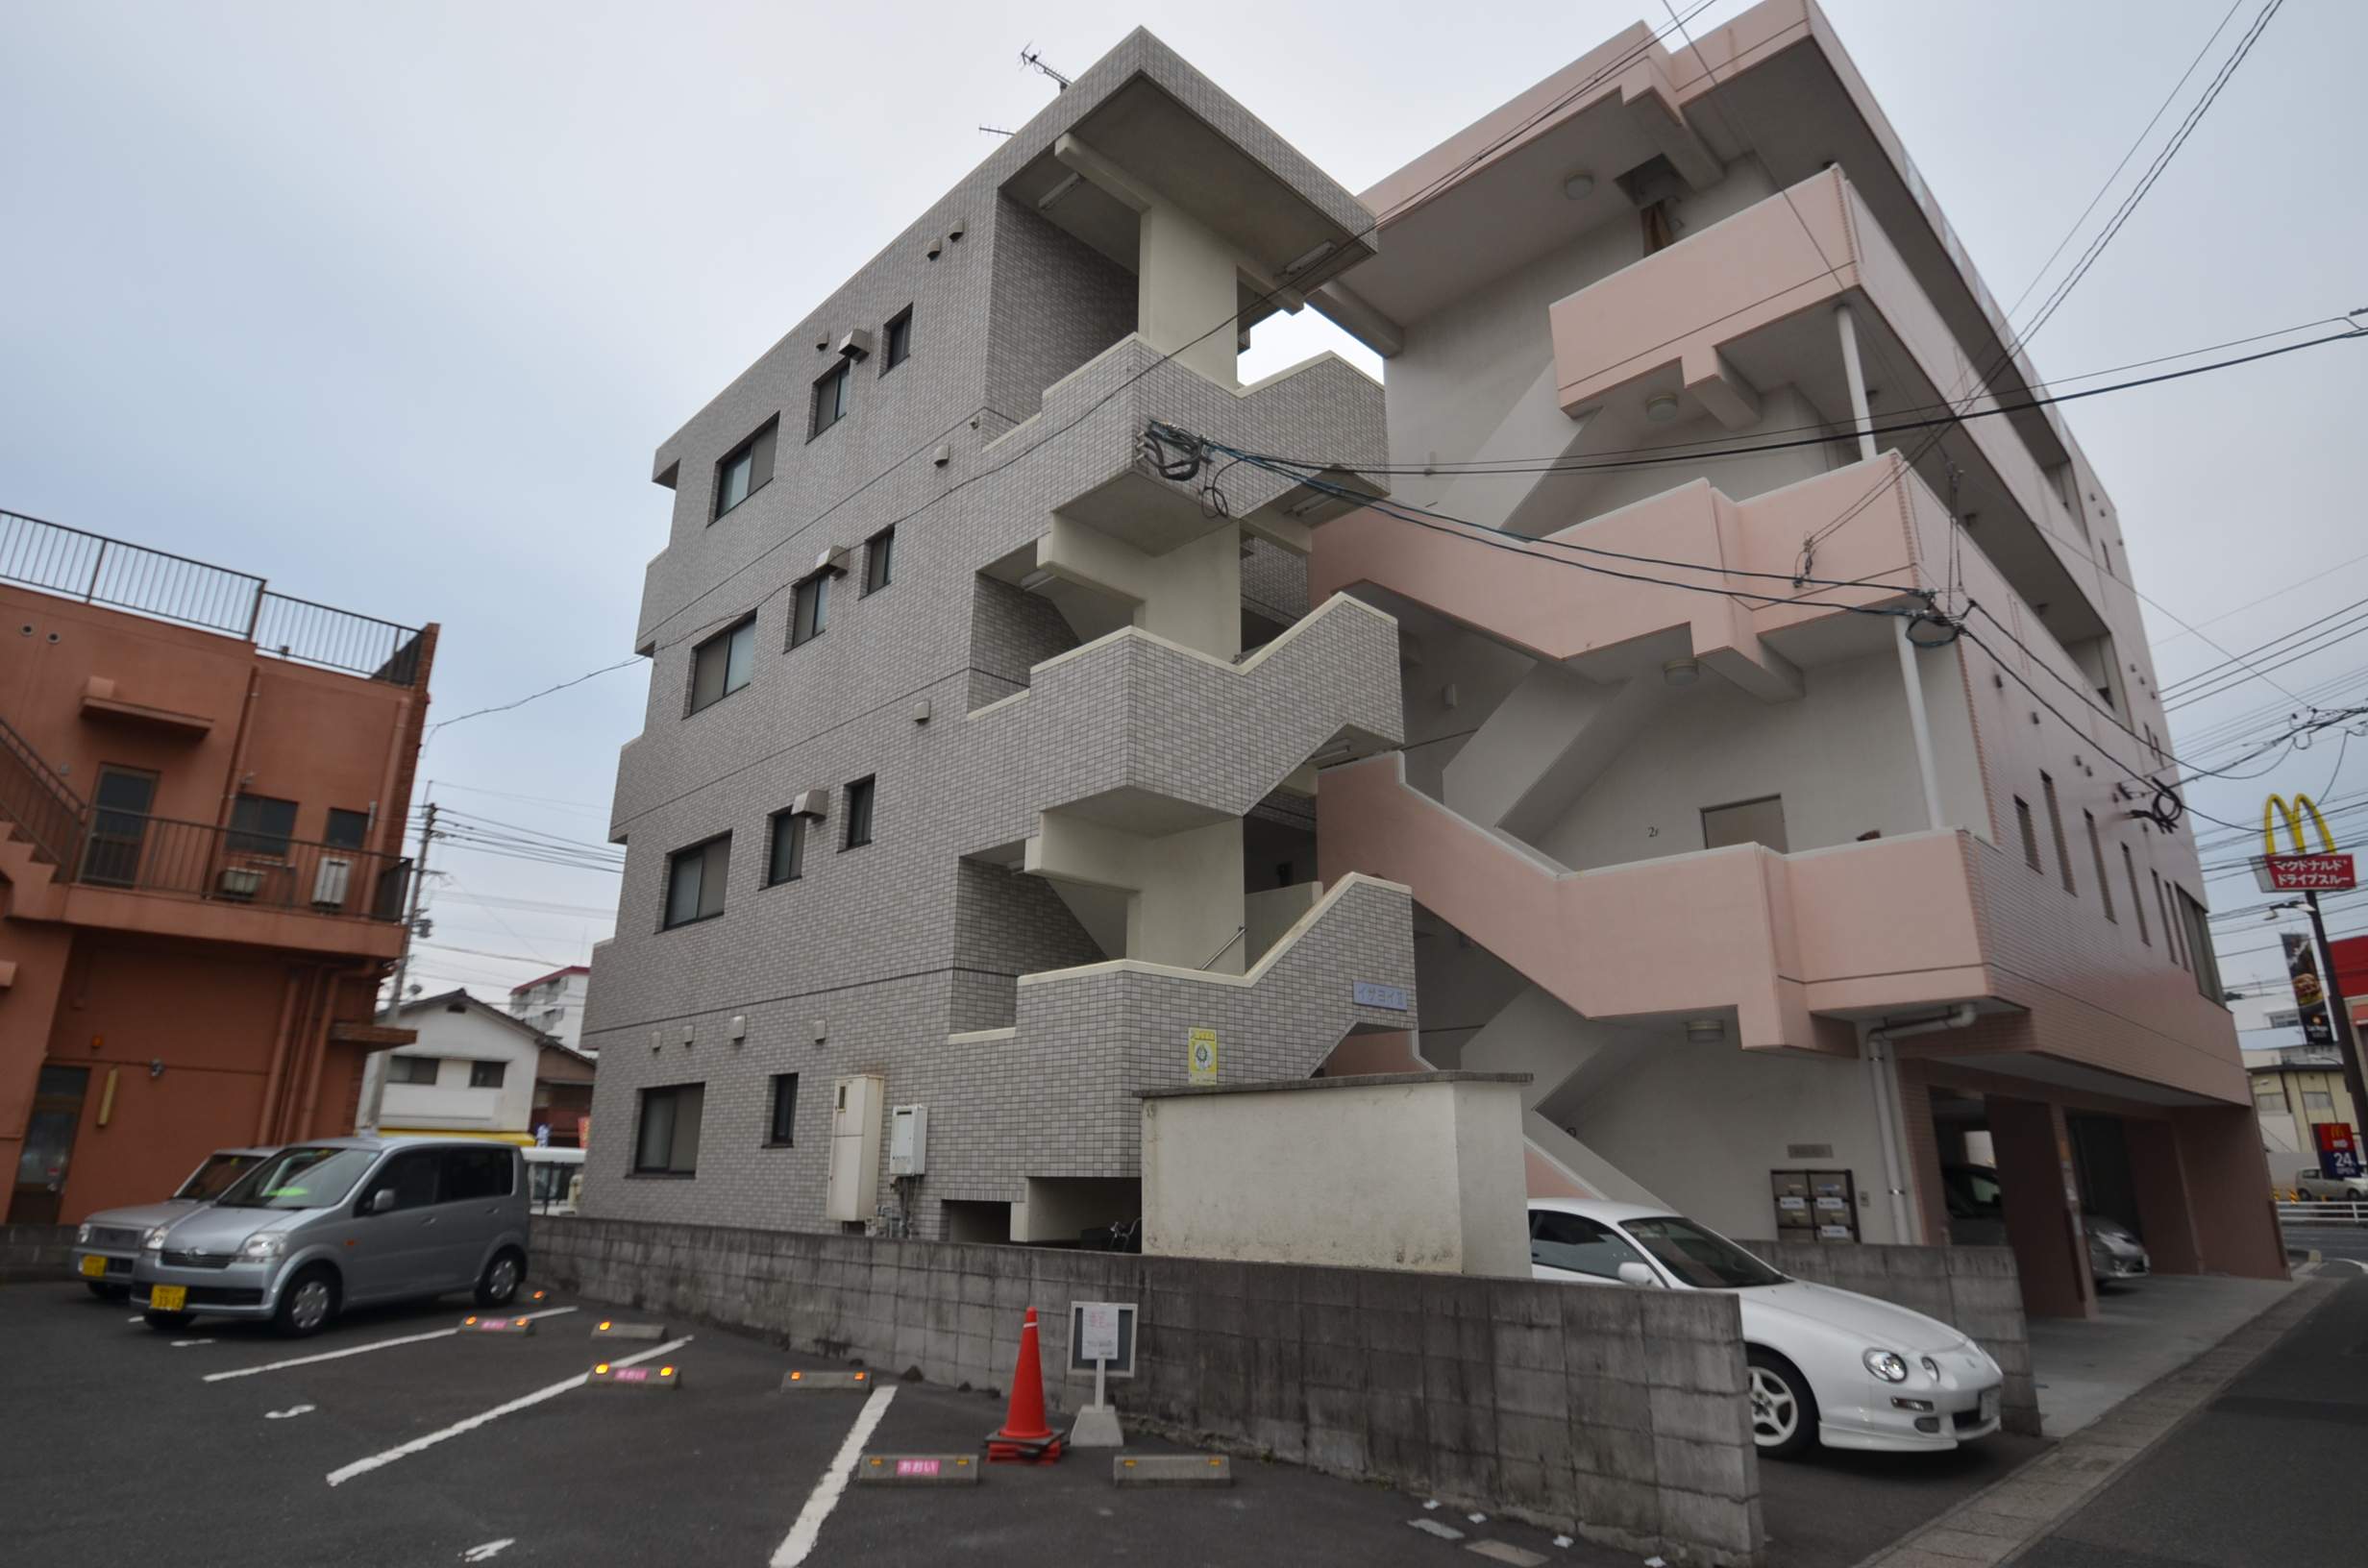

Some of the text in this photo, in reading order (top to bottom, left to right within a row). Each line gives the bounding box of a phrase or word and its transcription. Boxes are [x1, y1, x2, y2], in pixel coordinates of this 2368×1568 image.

[2273, 860, 2343, 872] マクドナルド
[2277, 872, 2352, 886] ドライブスルー
[2333, 1152, 2353, 1167] 24
